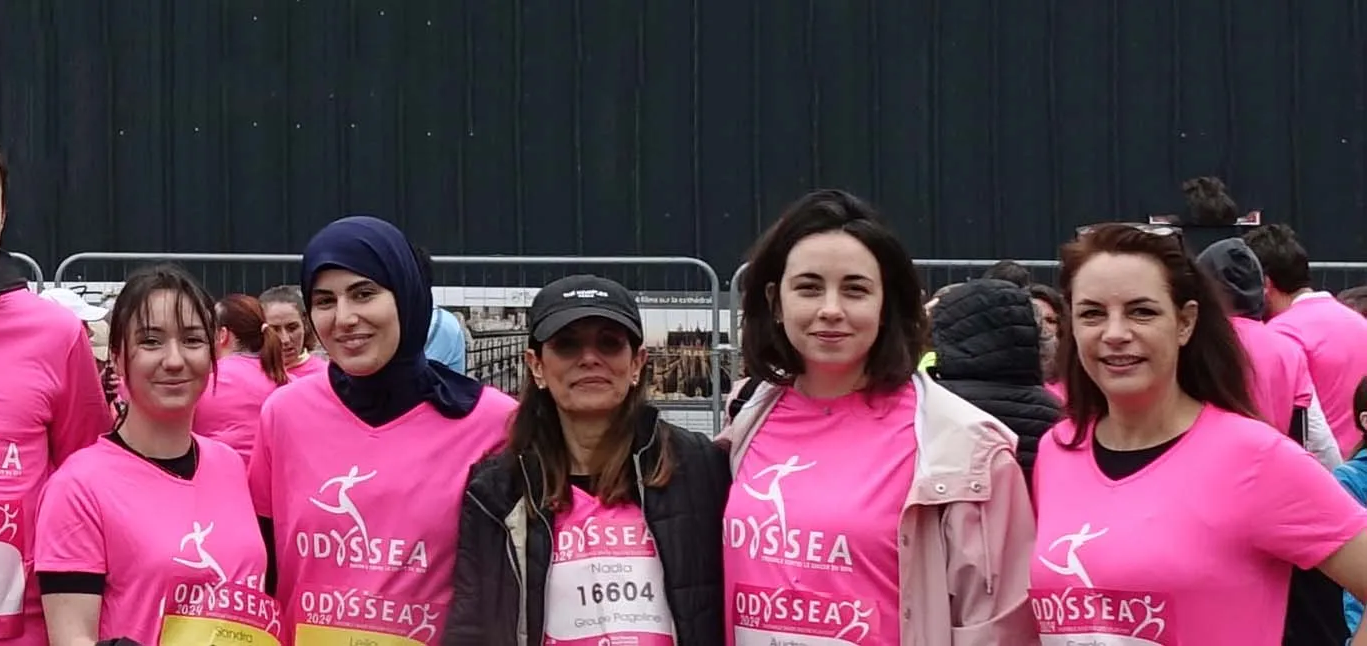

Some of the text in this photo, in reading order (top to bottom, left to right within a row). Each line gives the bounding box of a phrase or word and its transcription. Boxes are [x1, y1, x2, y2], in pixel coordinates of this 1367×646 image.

[296, 526, 428, 567] ODYSSEA
[558, 517, 654, 552] DYSSEA
[591, 563, 632, 573] Nadia
[175, 580, 268, 620] ODYSSEA
[302, 589, 413, 625] ODYSSEA
[577, 581, 654, 606] 16604
[736, 588, 841, 625] ODYSSEA
[216, 626, 253, 643] Sandra
[306, 613, 332, 624] 2024
